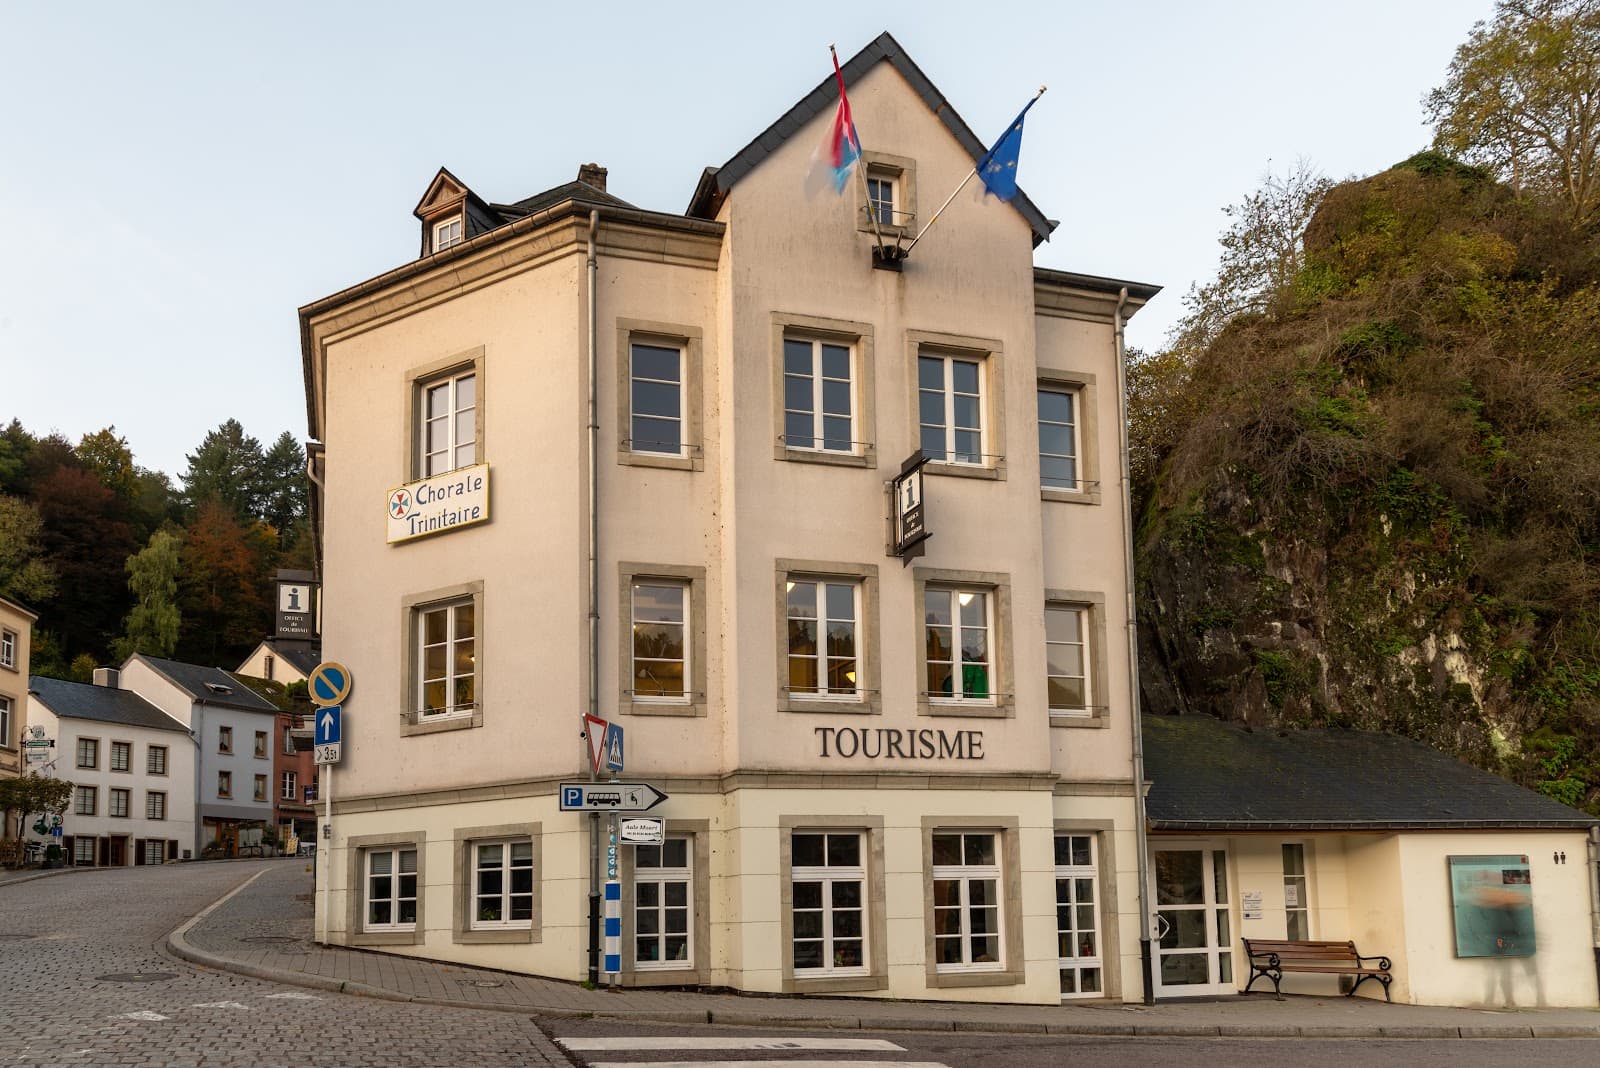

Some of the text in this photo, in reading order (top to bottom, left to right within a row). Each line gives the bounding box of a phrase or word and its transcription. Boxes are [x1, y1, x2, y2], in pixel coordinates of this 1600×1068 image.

[416, 475, 482, 505] Chorale
[406, 506, 480, 535] Trinitaire
[814, 727, 985, 760] TOURISME
[567, 789, 579, 805] P
